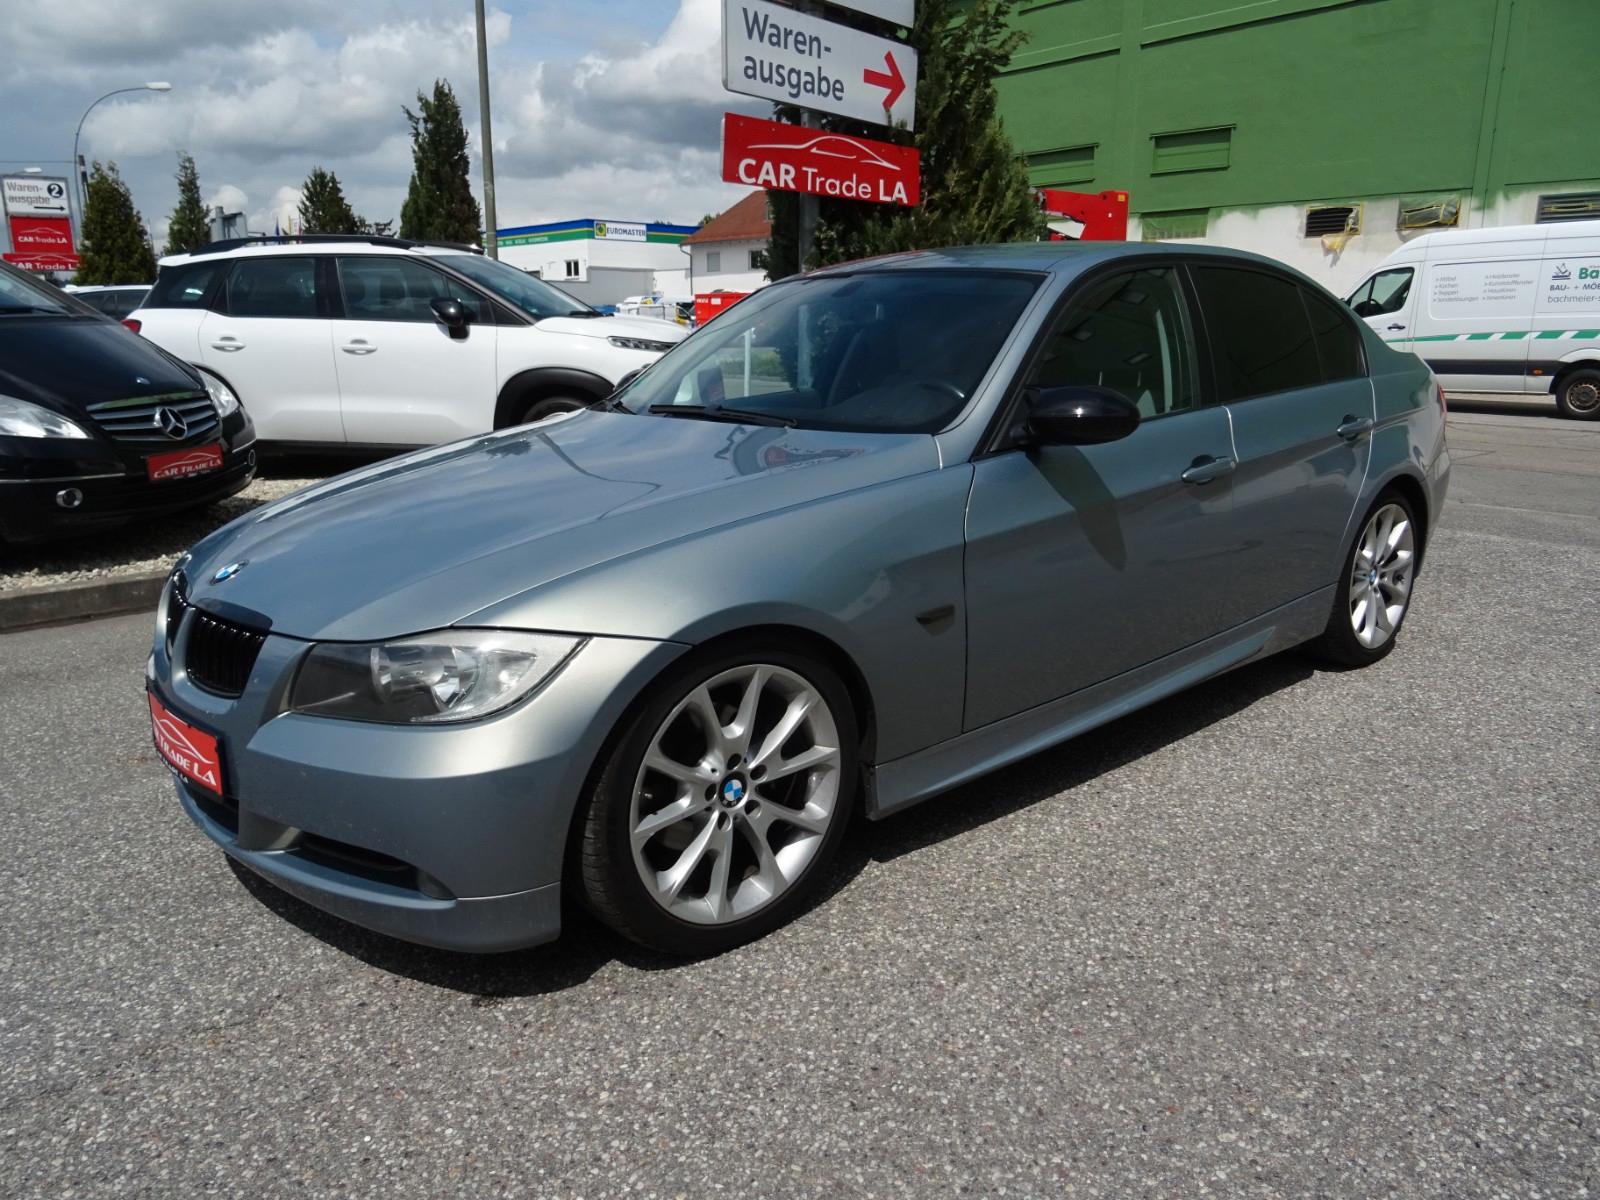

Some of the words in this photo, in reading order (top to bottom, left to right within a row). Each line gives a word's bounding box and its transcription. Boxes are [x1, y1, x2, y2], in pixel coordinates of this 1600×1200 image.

[742, 7, 832, 59] Waren-
[743, 55, 845, 101] ausgabe
[7, 182, 43, 193] Waren-
[738, 158, 796, 189] CAR
[801, 166, 872, 199] Trade
[879, 179, 908, 203] LA
[8, 195, 51, 205] ausgabe
[606, 227, 646, 237] EUROMASTER
[35, 262, 66, 270] Trade
[154, 467, 178, 478] CAR
[209, 458, 222, 467] LA
[159, 735, 191, 768] TRADE
[193, 762, 217, 786] LA
